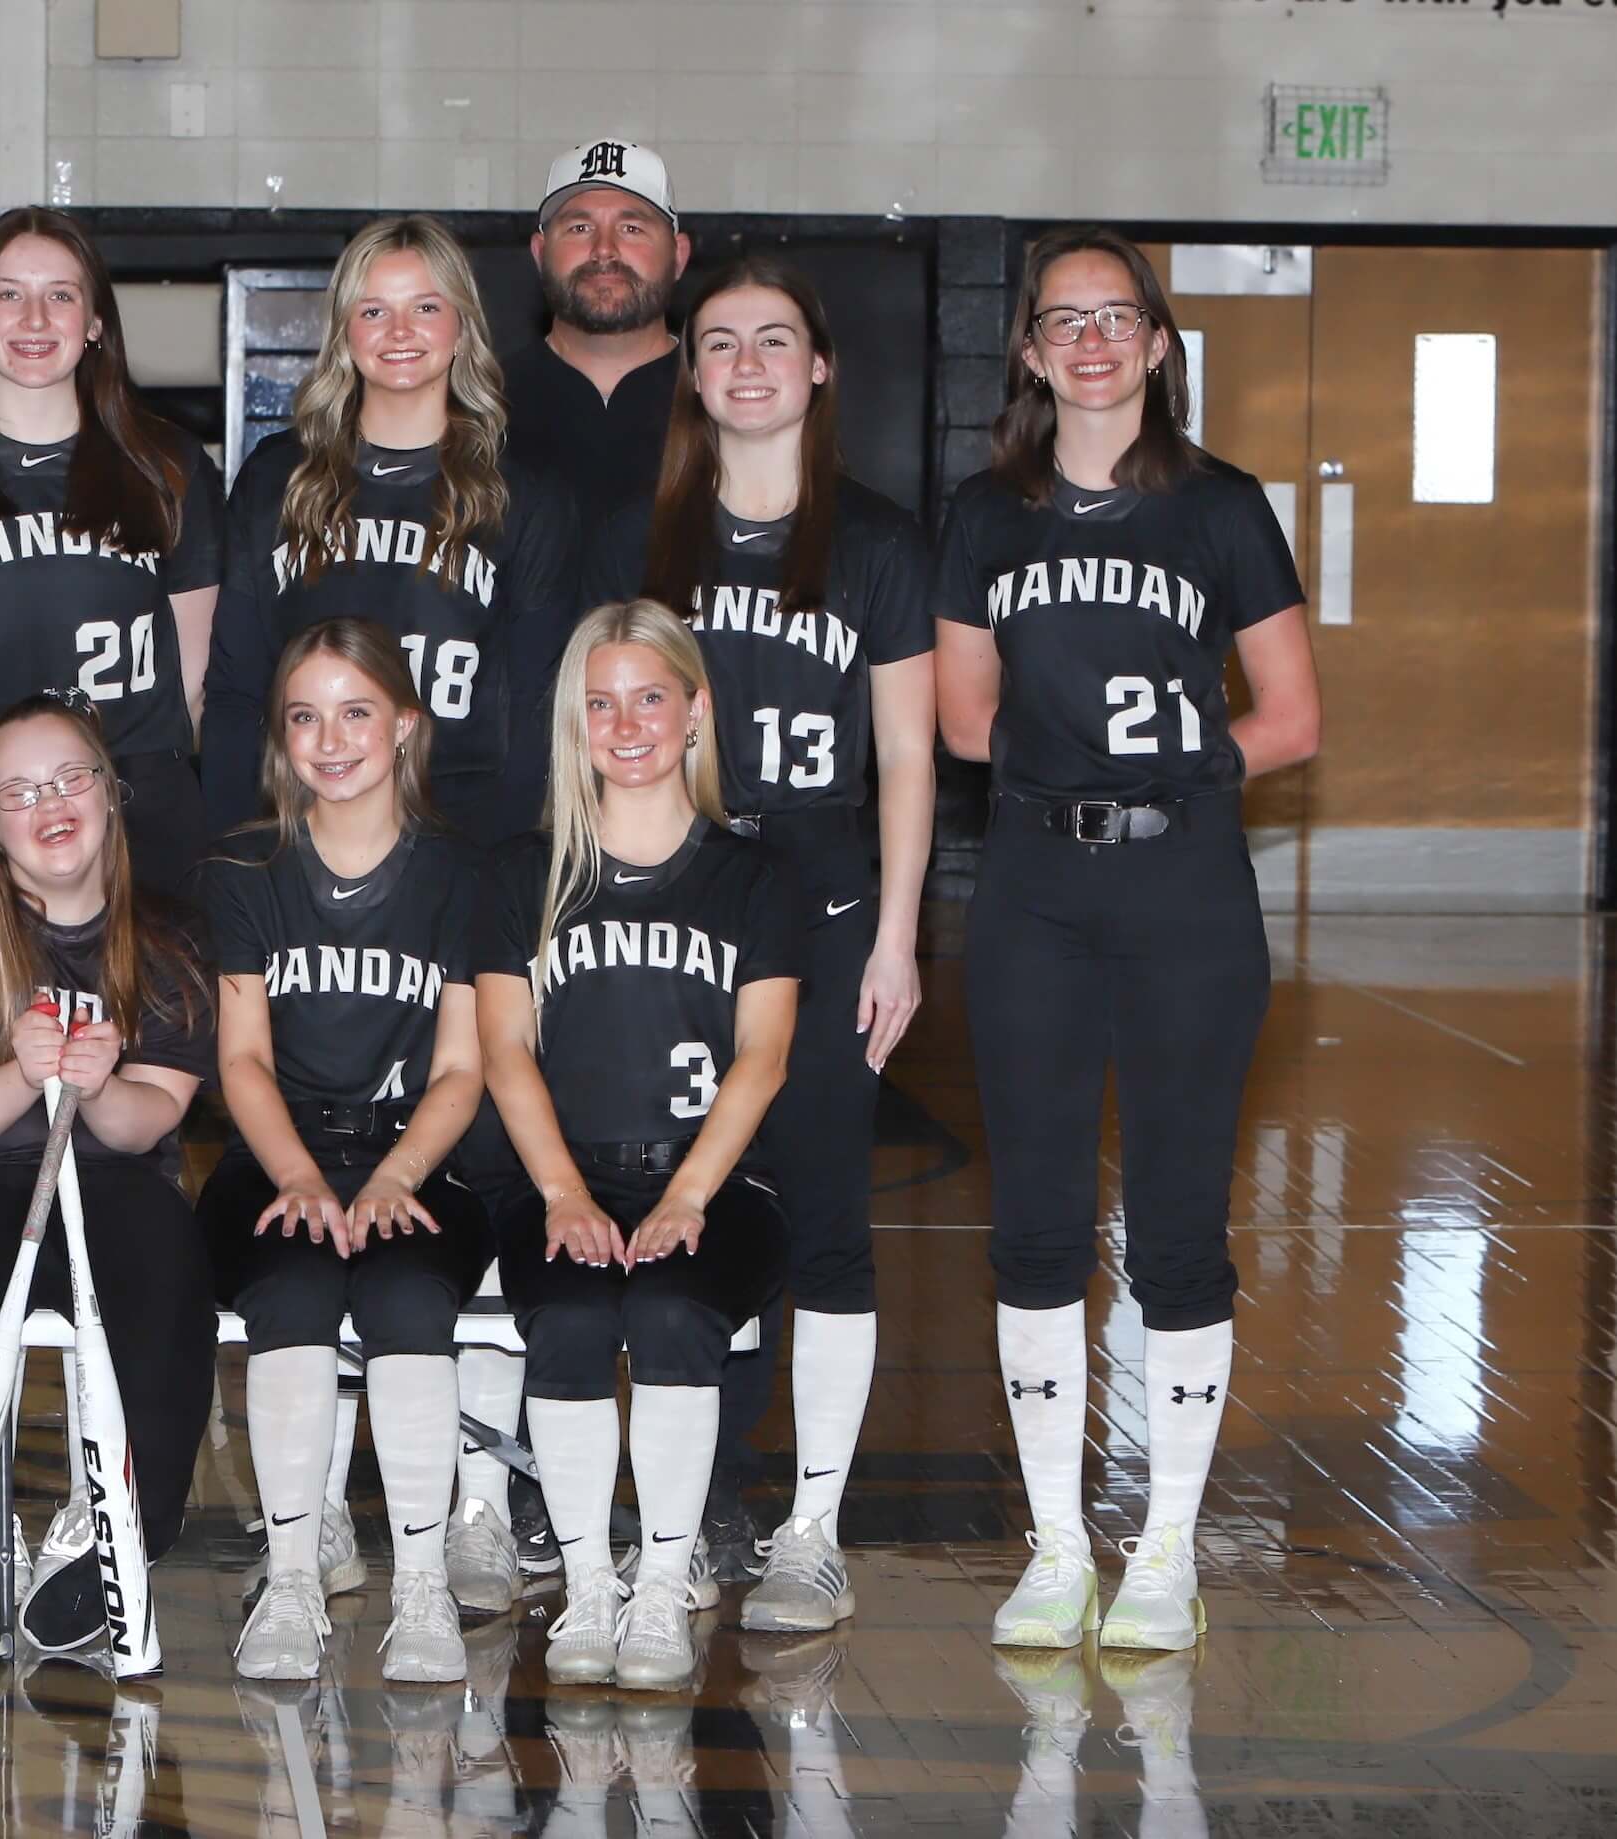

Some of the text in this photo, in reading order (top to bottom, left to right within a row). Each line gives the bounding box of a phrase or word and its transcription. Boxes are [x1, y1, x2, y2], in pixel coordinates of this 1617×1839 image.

[1296, 104, 1369, 159] EXIT
[987, 557, 1206, 641] MANDAN
[75, 612, 156, 702] 20
[400, 633, 480, 719] 18
[753, 707, 835, 789] 13
[1105, 675, 1202, 755] 21
[669, 1042, 719, 1119] 3
[81, 1437, 132, 1657] EASTON
